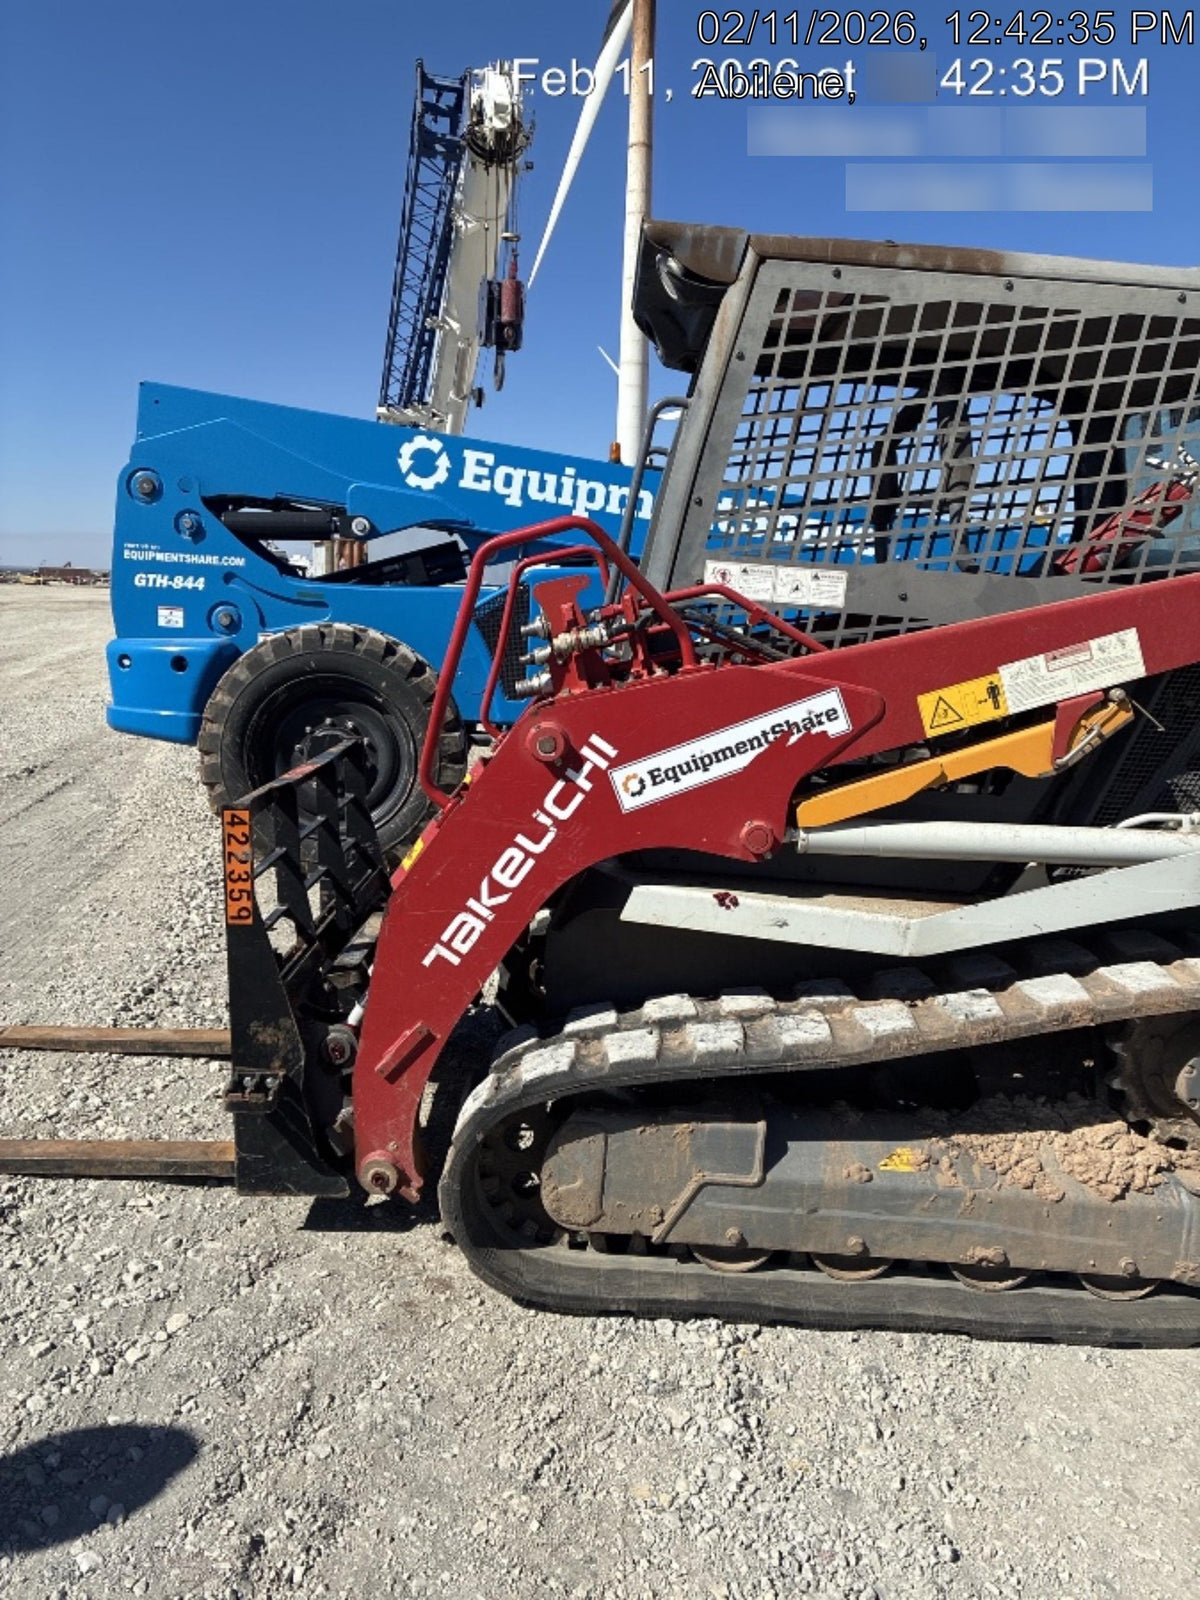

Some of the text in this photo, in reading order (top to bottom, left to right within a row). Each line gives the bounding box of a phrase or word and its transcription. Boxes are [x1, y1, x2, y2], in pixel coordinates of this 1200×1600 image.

[123, 549, 246, 567] EQUIPMENTSHARE.COM
[134, 573, 205, 591] GTH-844
[226, 812, 252, 921] 422359
